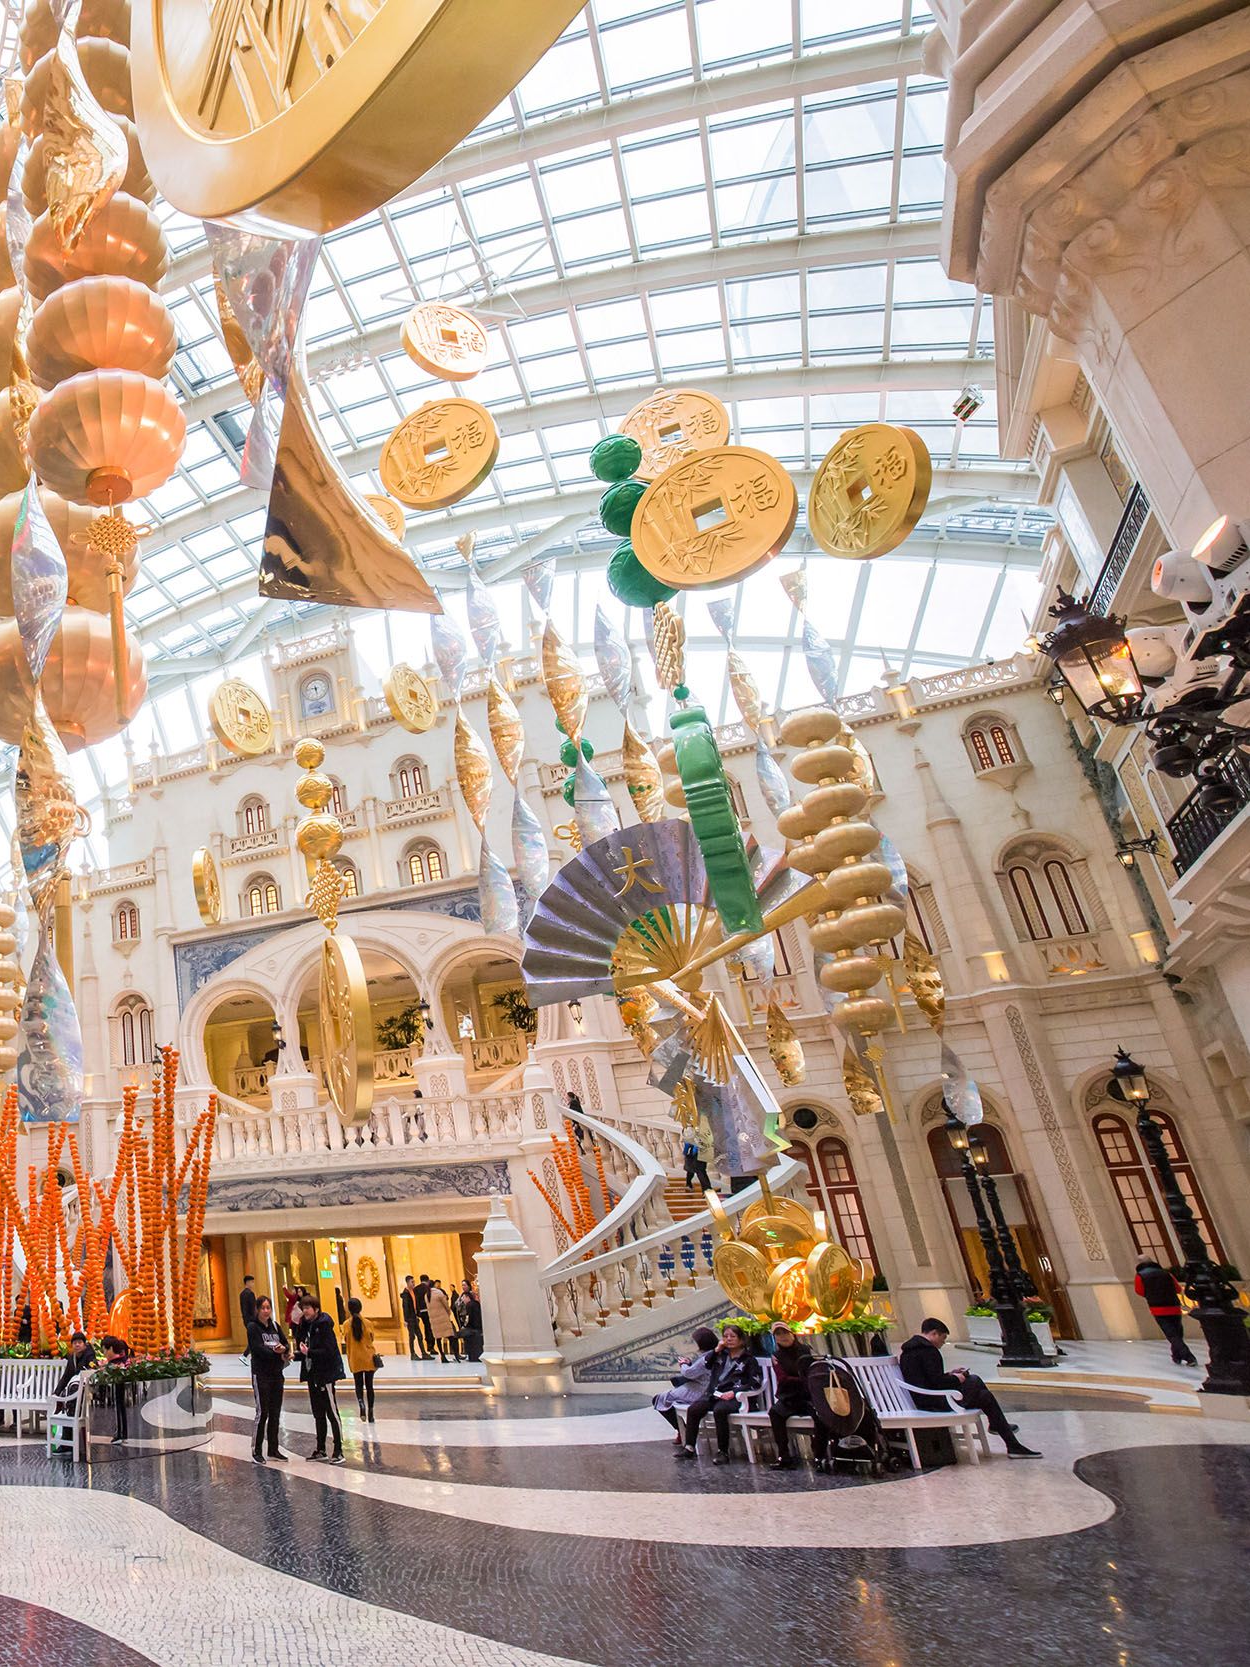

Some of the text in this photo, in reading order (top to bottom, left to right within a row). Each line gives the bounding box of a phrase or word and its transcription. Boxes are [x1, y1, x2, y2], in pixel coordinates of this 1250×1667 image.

[451, 419, 487, 455] 福
[685, 408, 721, 440] 福
[871, 443, 908, 490] 福
[730, 472, 781, 519] 福
[613, 846, 668, 898] 大
